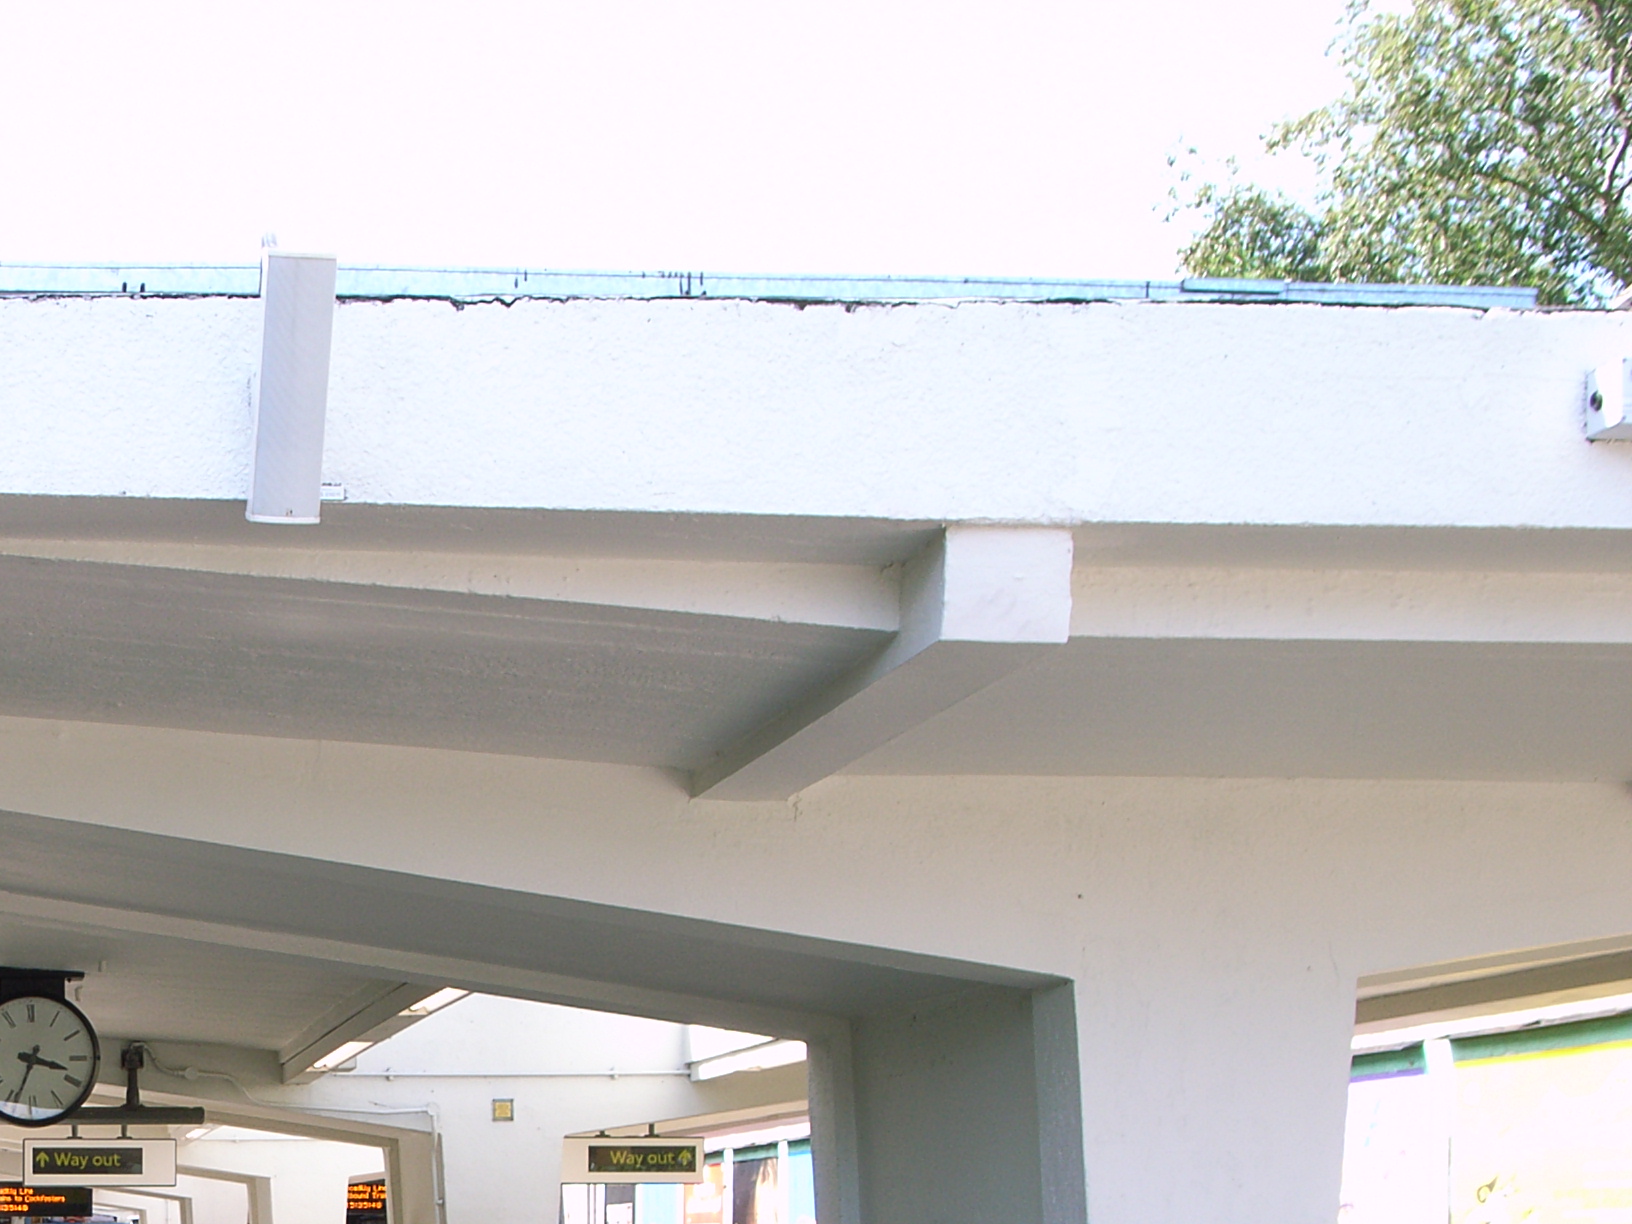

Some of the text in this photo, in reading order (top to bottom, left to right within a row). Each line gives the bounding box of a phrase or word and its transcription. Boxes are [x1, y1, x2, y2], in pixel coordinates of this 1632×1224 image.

[53, 1151, 121, 1169] Way out
[609, 1150, 675, 1168] Way out
